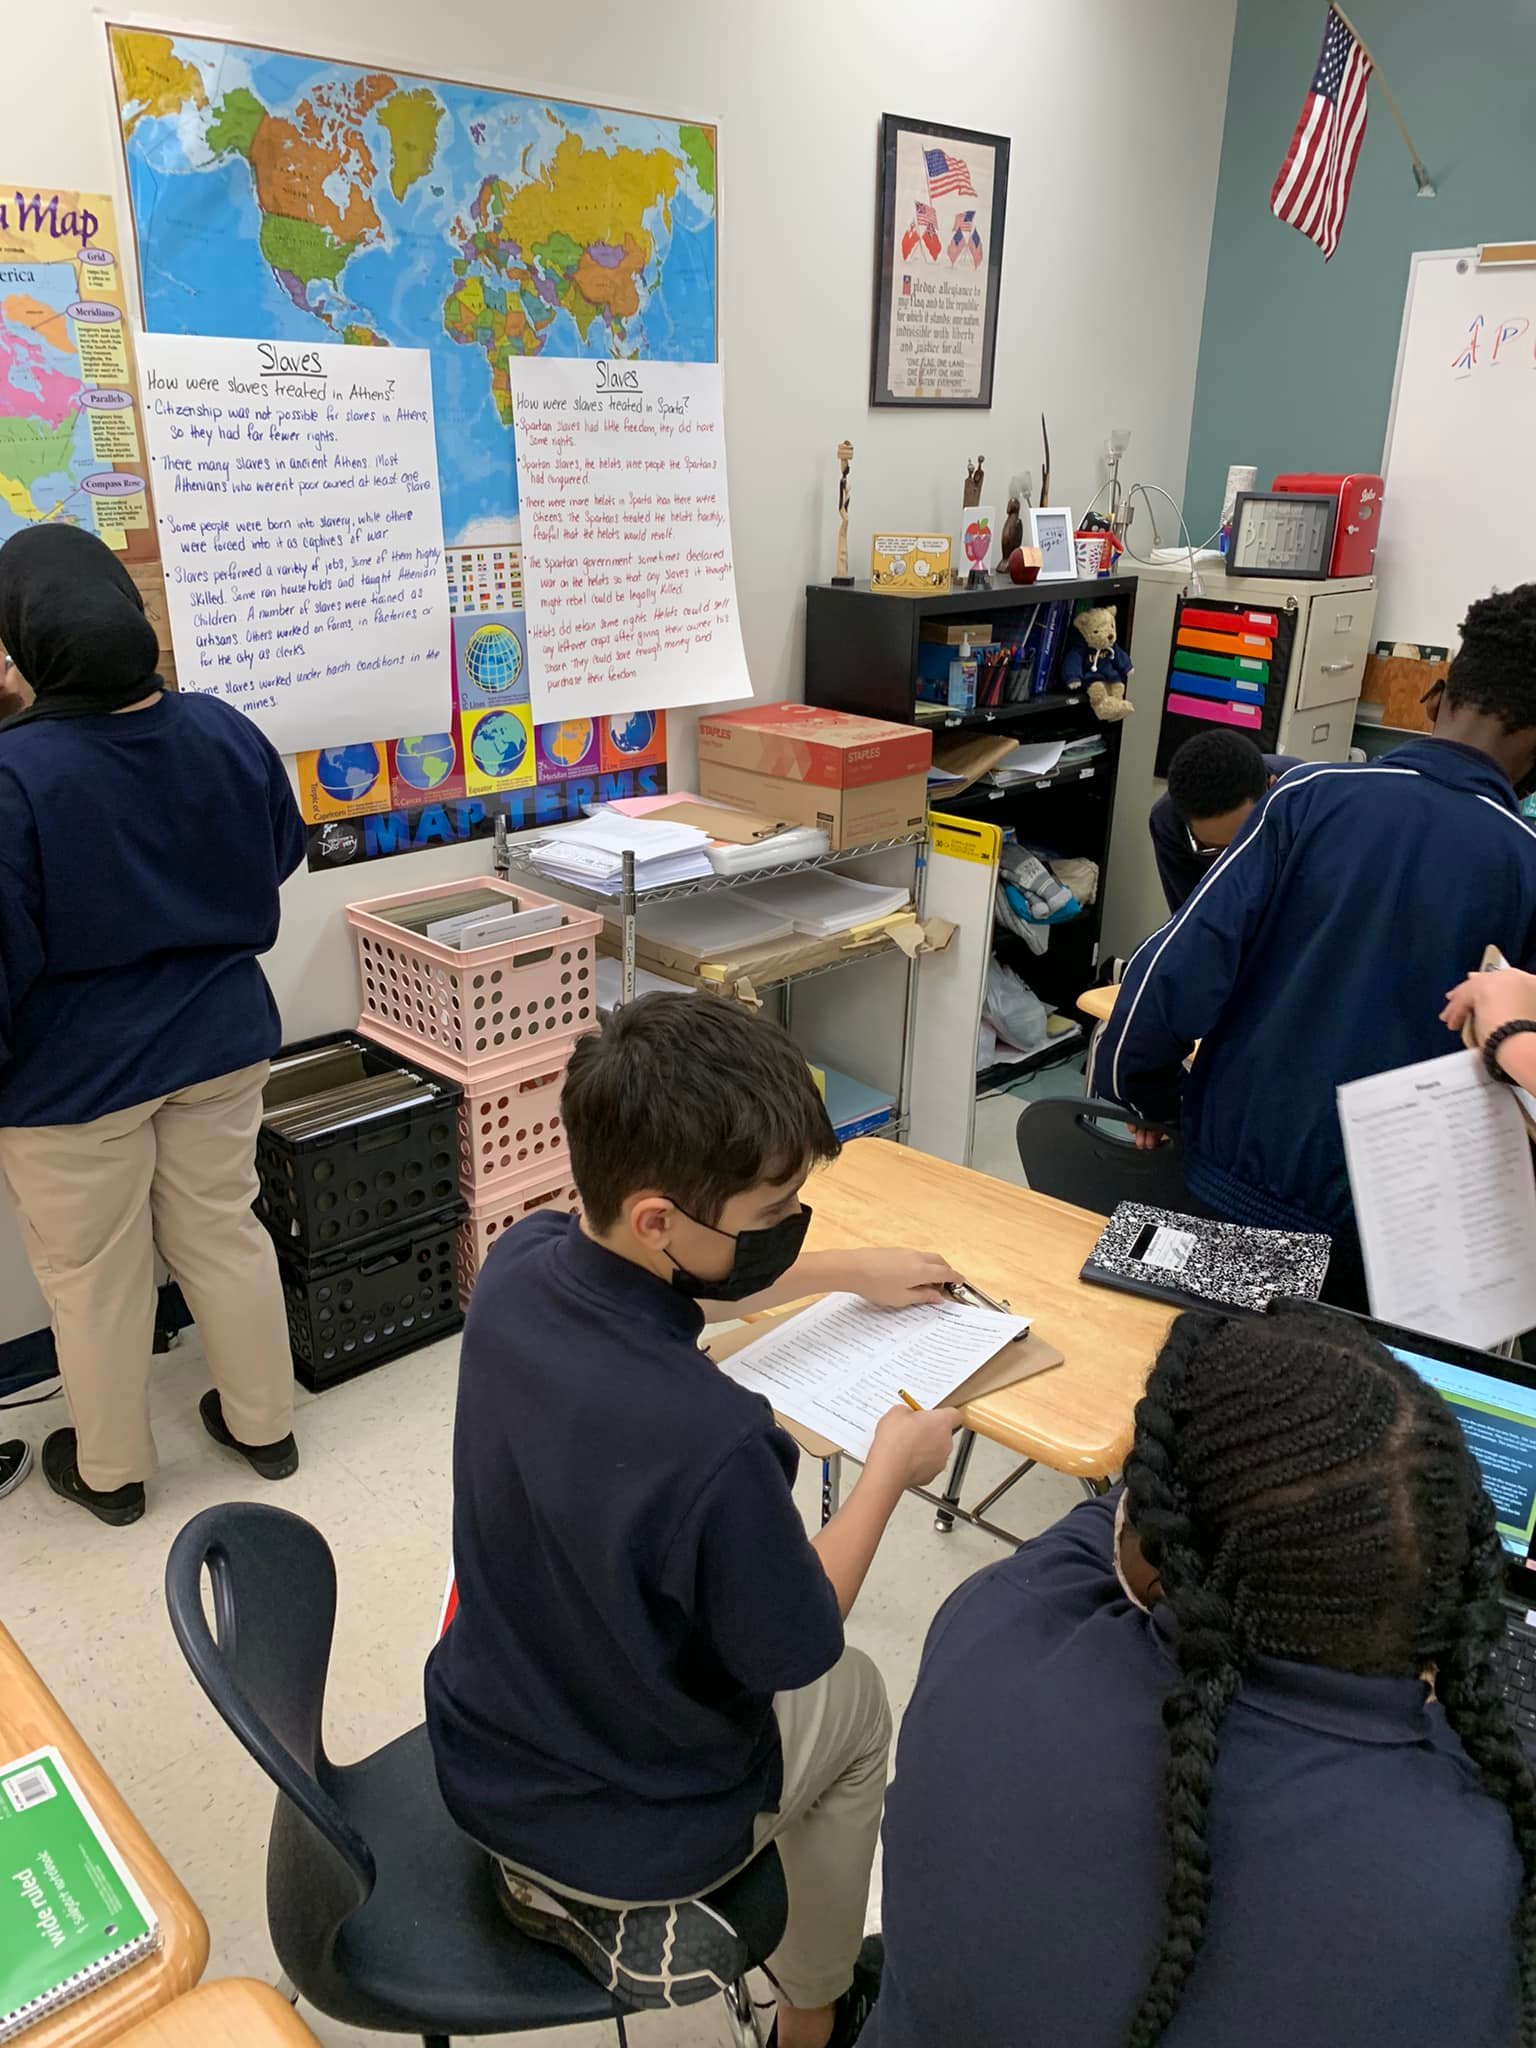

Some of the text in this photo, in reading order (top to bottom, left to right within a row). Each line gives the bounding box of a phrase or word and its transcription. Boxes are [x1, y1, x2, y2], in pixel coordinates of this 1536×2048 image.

[15, 191, 99, 248] Map
[87, 252, 106, 262] Grid
[75, 306, 115, 317] Meridians
[257, 342, 323, 373] Slaves
[147, 370, 396, 401] How were slaves treated in Athens?
[596, 360, 639, 388] Slaves
[90, 394, 124, 404] Parallels
[516, 391, 690, 420] How were slaves treated in Sparta?
[154, 400, 223, 424] Citizenship
[228, 407, 250, 420] was
[255, 404, 271, 420] not
[278, 407, 318, 426] possible
[326, 404, 339, 422] for
[345, 408, 375, 422] slaves
[382, 412, 391, 423] in
[190, 423, 213, 447] they
[218, 424, 240, 440] had
[246, 423, 264, 442] far
[269, 424, 300, 441] fewer
[520, 416, 552, 436] Spartan
[556, 419, 580, 432] slaves
[585, 418, 599, 432] had
[604, 418, 620, 432] little
[660, 424, 674, 438] they
[678, 419, 692, 433] did
[696, 419, 714, 432] have
[161, 455, 193, 472] There
[198, 461, 231, 481] many
[236, 456, 271, 471] slaves
[276, 456, 285, 470] in
[290, 456, 328, 470] ancient
[86, 479, 122, 491] Compass
[174, 475, 228, 493] Athenians
[232, 477, 252, 493] who
[299, 480, 319, 497] poor
[322, 477, 354, 491] owned
[358, 475, 370, 488] at
[374, 472, 399, 486] least
[401, 471, 419, 483] one
[406, 480, 431, 493] slave
[167, 514, 196, 534] Some
[200, 520, 230, 536] people
[236, 520, 262, 532] were
[267, 516, 292, 530] born
[297, 518, 315, 529] into
[358, 511, 381, 525] while
[386, 510, 413, 523] others
[533, 523, 560, 543] fearful
[597, 527, 620, 540] helots
[624, 527, 647, 541] would
[181, 527, 389, 553] were forced into it as captives of war
[174, 565, 209, 584] Slaves
[213, 561, 262, 585] performed
[266, 566, 274, 577] a
[312, 556, 321, 571] of
[351, 555, 372, 568] some
[376, 549, 388, 564] of
[392, 550, 412, 561] them
[416, 547, 441, 569] highly
[530, 555, 541, 569] The
[582, 552, 632, 577] government
[638, 550, 680, 565] sometimes
[686, 548, 725, 562] declared
[231, 584, 256, 602] Some
[261, 589, 276, 599] ran
[281, 577, 332, 595] households
[338, 575, 355, 589] and
[361, 570, 391, 594] taught
[398, 567, 437, 582] Athenian
[247, 605, 255, 622] A
[258, 603, 295, 619] number
[300, 599, 311, 615] of
[314, 601, 341, 614] slaves
[345, 598, 367, 610] were
[371, 589, 405, 605] trained
[411, 588, 424, 600] as
[540, 598, 562, 616] might
[566, 593, 587, 607] rebel
[591, 589, 612, 604] could
[616, 591, 625, 602] be
[630, 587, 657, 608] legally
[200, 650, 213, 668] for
[217, 653, 233, 667] the
[236, 649, 255, 670] city
[258, 648, 271, 661] as
[700, 724, 732, 740] STAPLES
[848, 747, 881, 763] STAPLES
[363, 766, 659, 857] MAP TERMS
[12, 1867, 67, 1949] wide ruled
